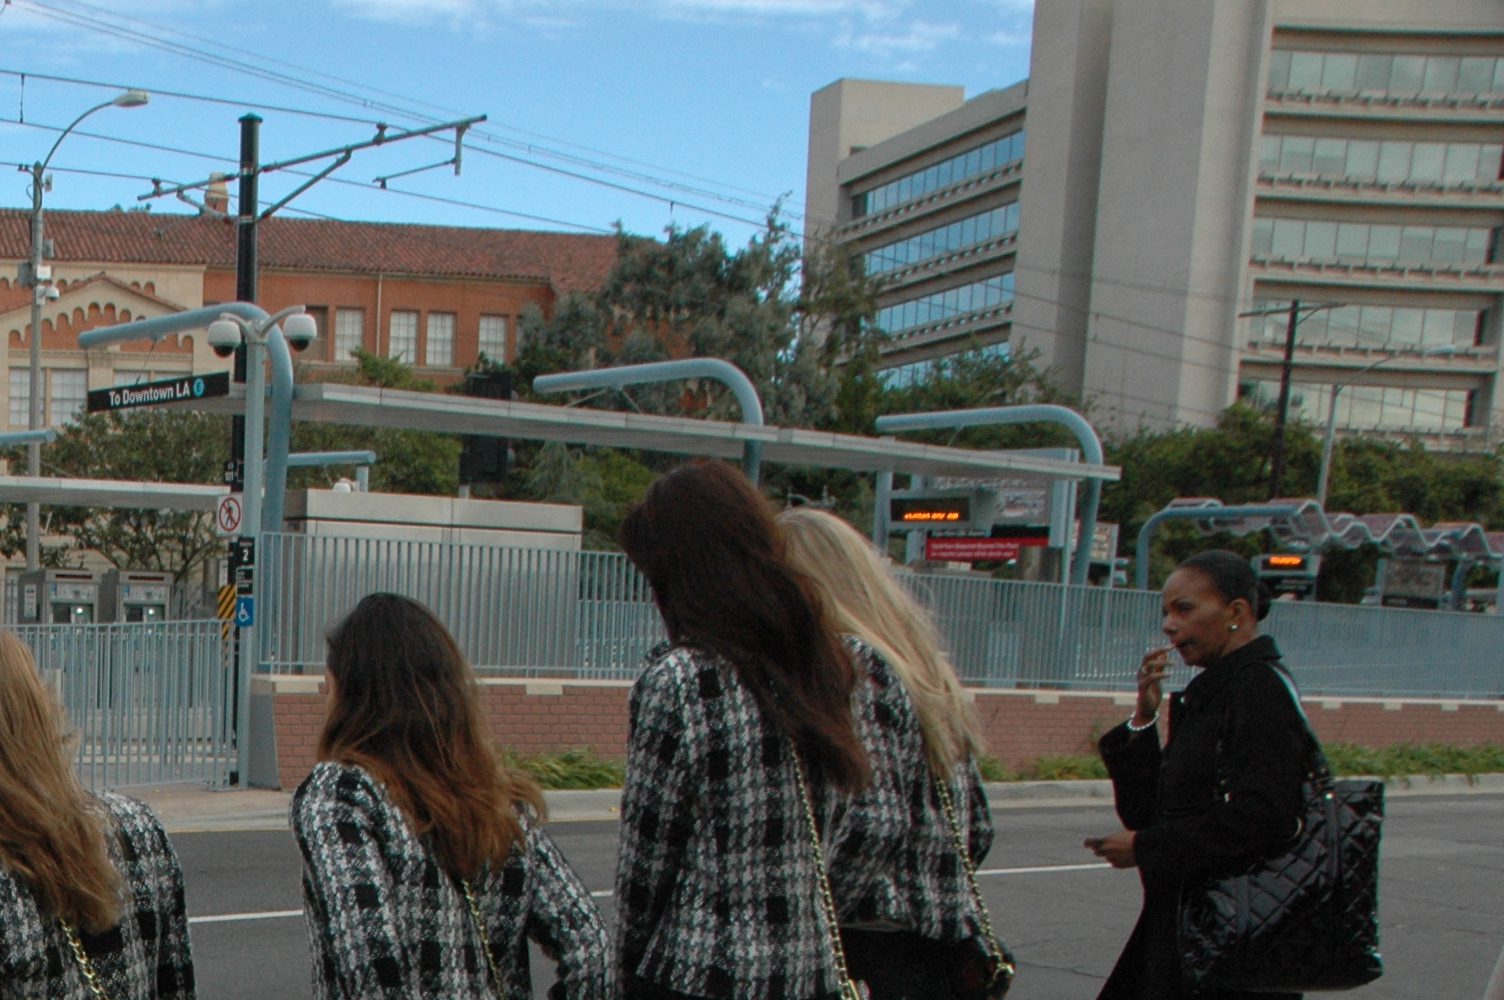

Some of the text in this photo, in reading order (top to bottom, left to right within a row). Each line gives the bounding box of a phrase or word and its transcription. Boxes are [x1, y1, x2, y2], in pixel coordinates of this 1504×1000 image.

[108, 381, 190, 406] To Downtown LA
[242, 548, 249, 561] 2
